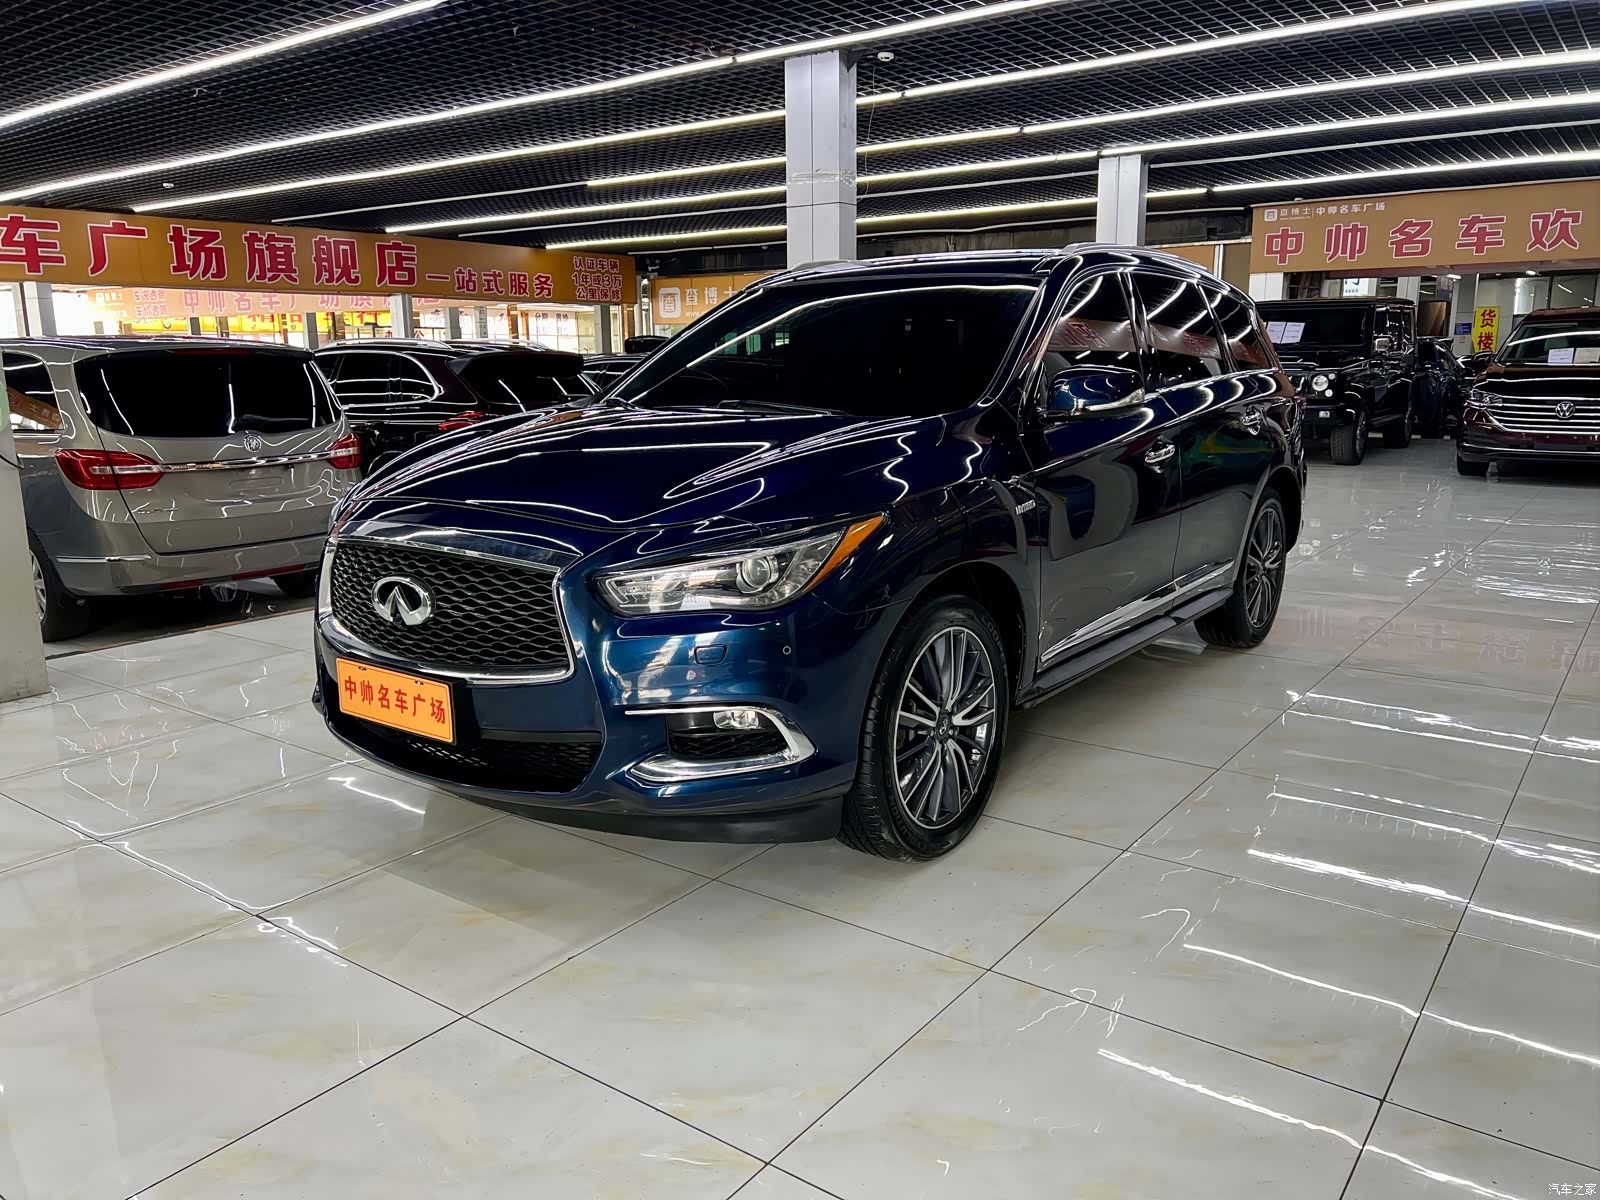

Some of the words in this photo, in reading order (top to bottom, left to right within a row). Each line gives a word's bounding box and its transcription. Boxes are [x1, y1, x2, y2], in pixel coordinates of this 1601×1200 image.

[1264, 208, 1583, 266] 中帅名车欢
[0, 214, 417, 287] 车广场旗舰店
[426, 267, 553, 298] 一站式服务
[573, 256, 620, 272] 认证车辆
[571, 272, 622, 289] 1年或3万
[576, 286, 621, 301] 公里保修
[344, 675, 446, 725] 中帅名车广场
